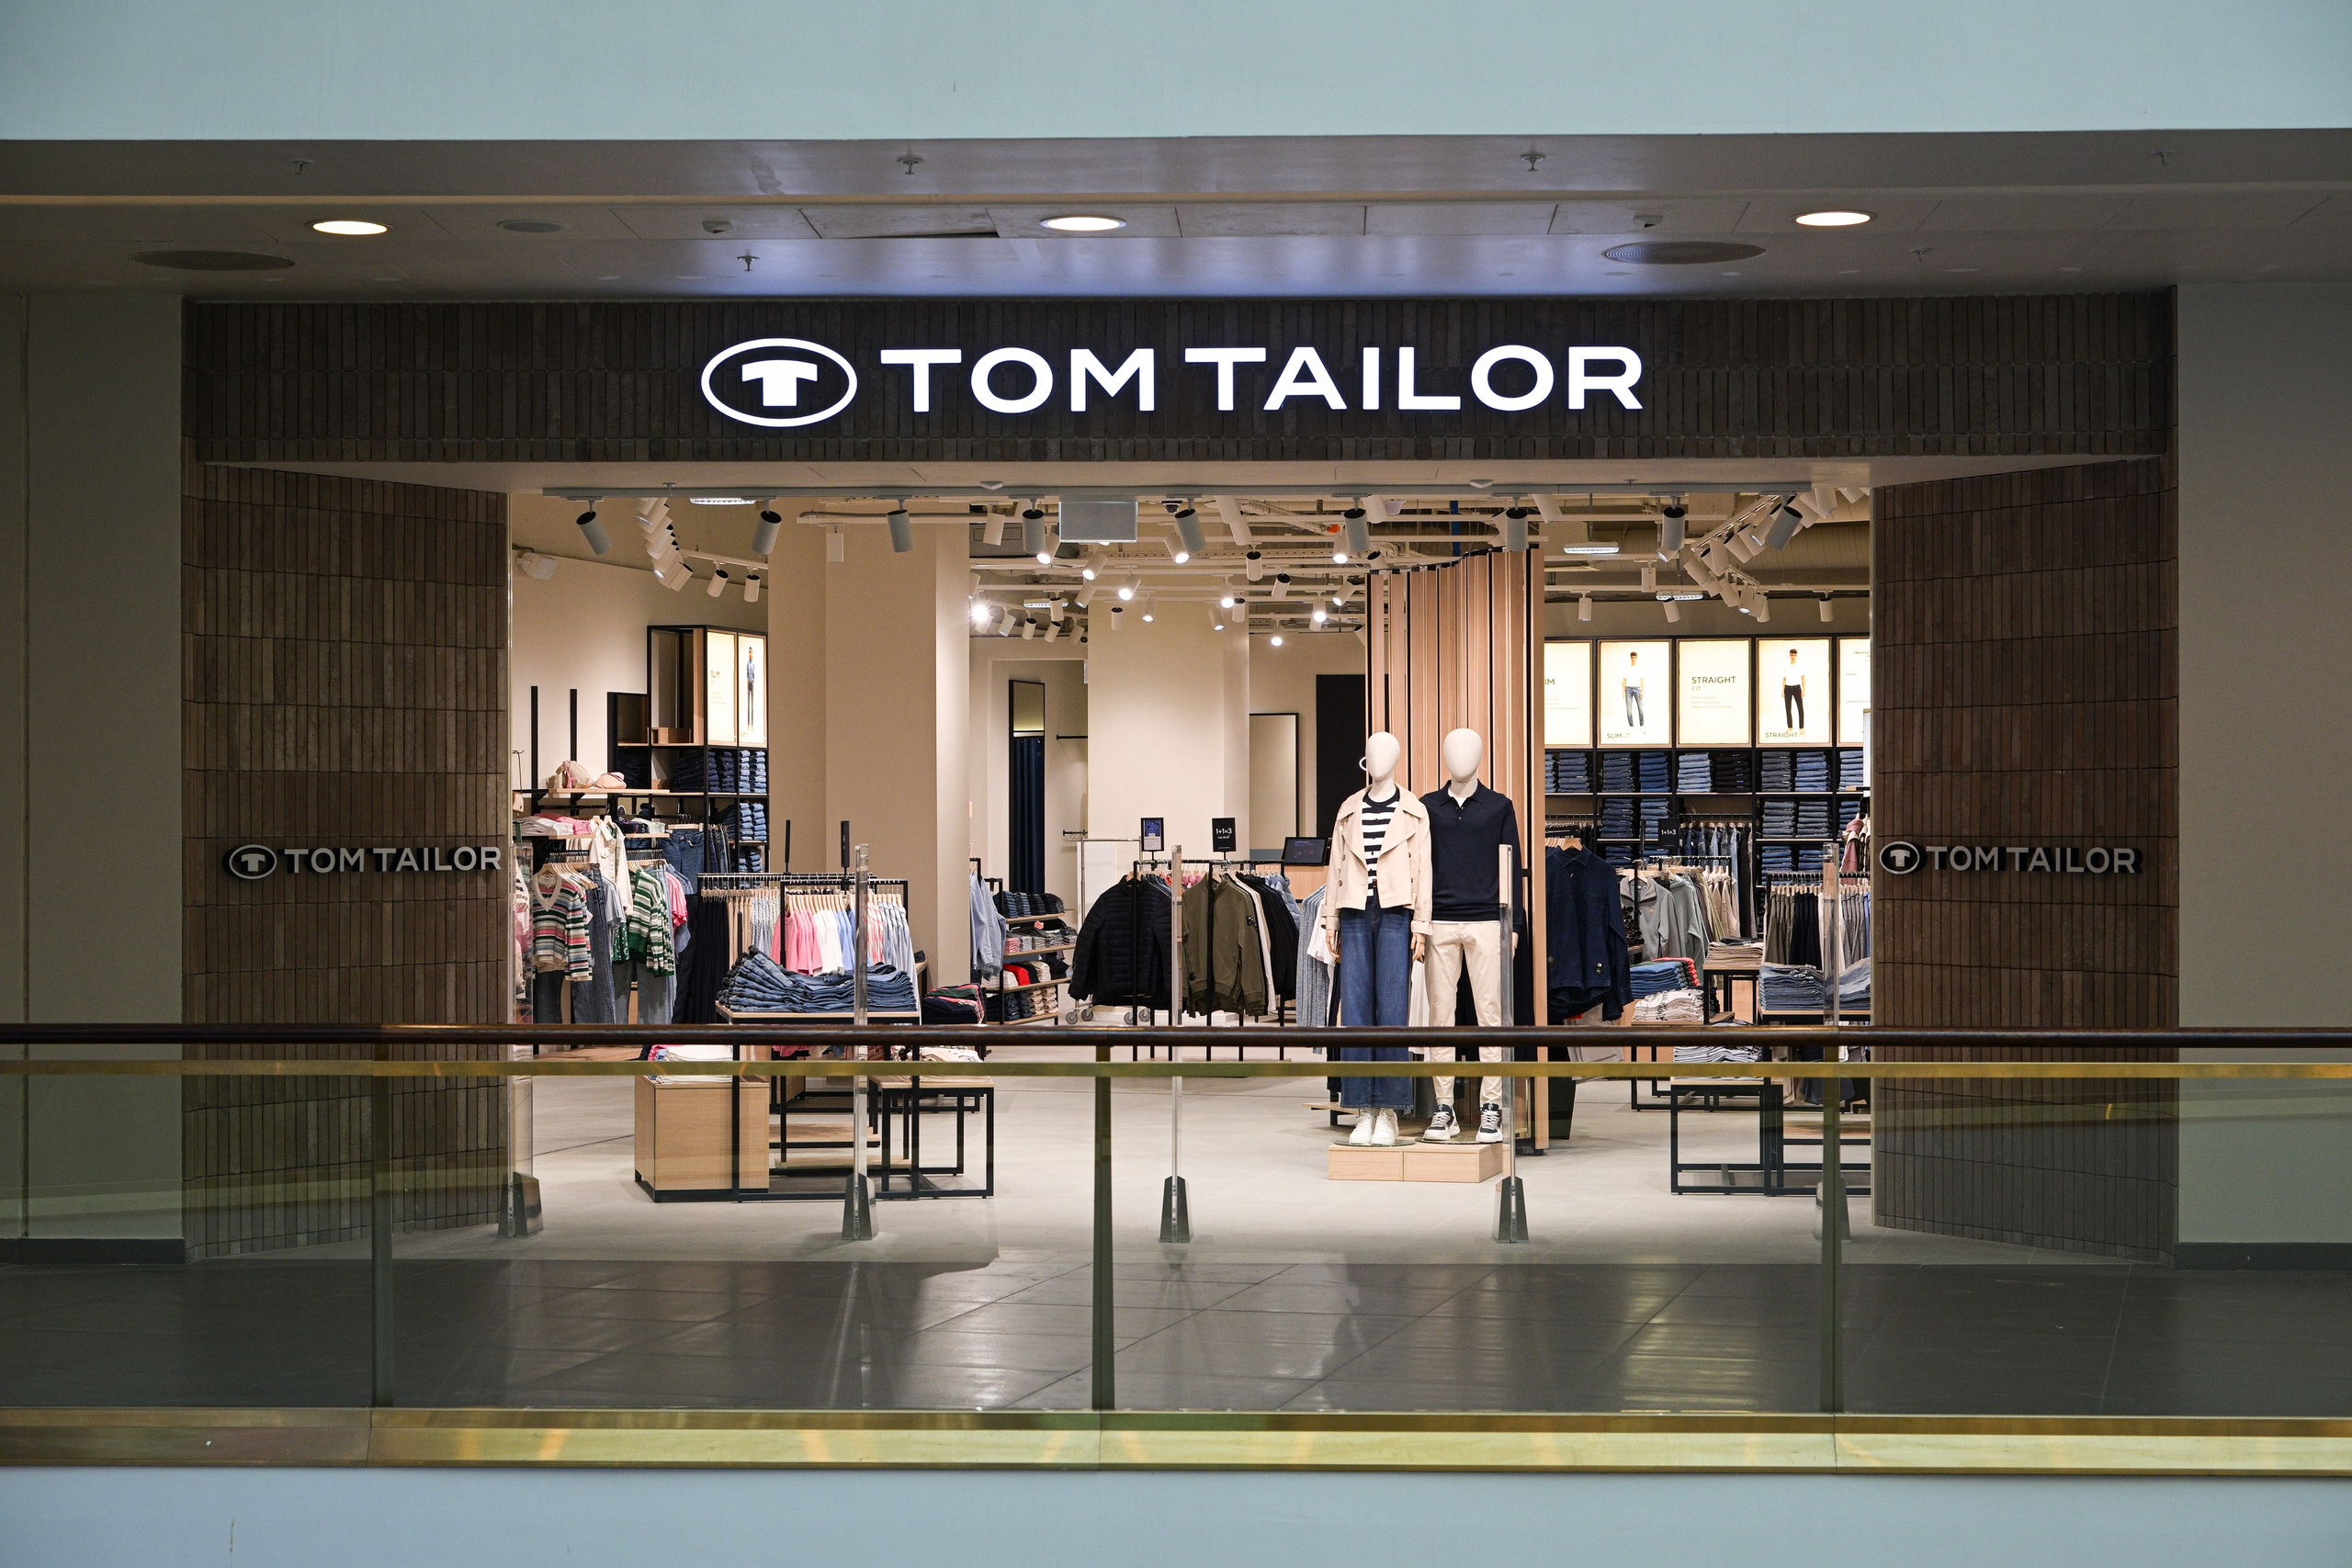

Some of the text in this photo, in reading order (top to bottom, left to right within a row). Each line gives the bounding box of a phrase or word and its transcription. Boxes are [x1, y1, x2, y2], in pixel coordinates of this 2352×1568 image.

[880, 344, 1645, 413] TOM TAILOR
[1691, 675, 1736, 684] STRAIGHT
[284, 846, 502, 874] TOM TAILOR
[1926, 845, 2136, 874] TOM TAILOR
